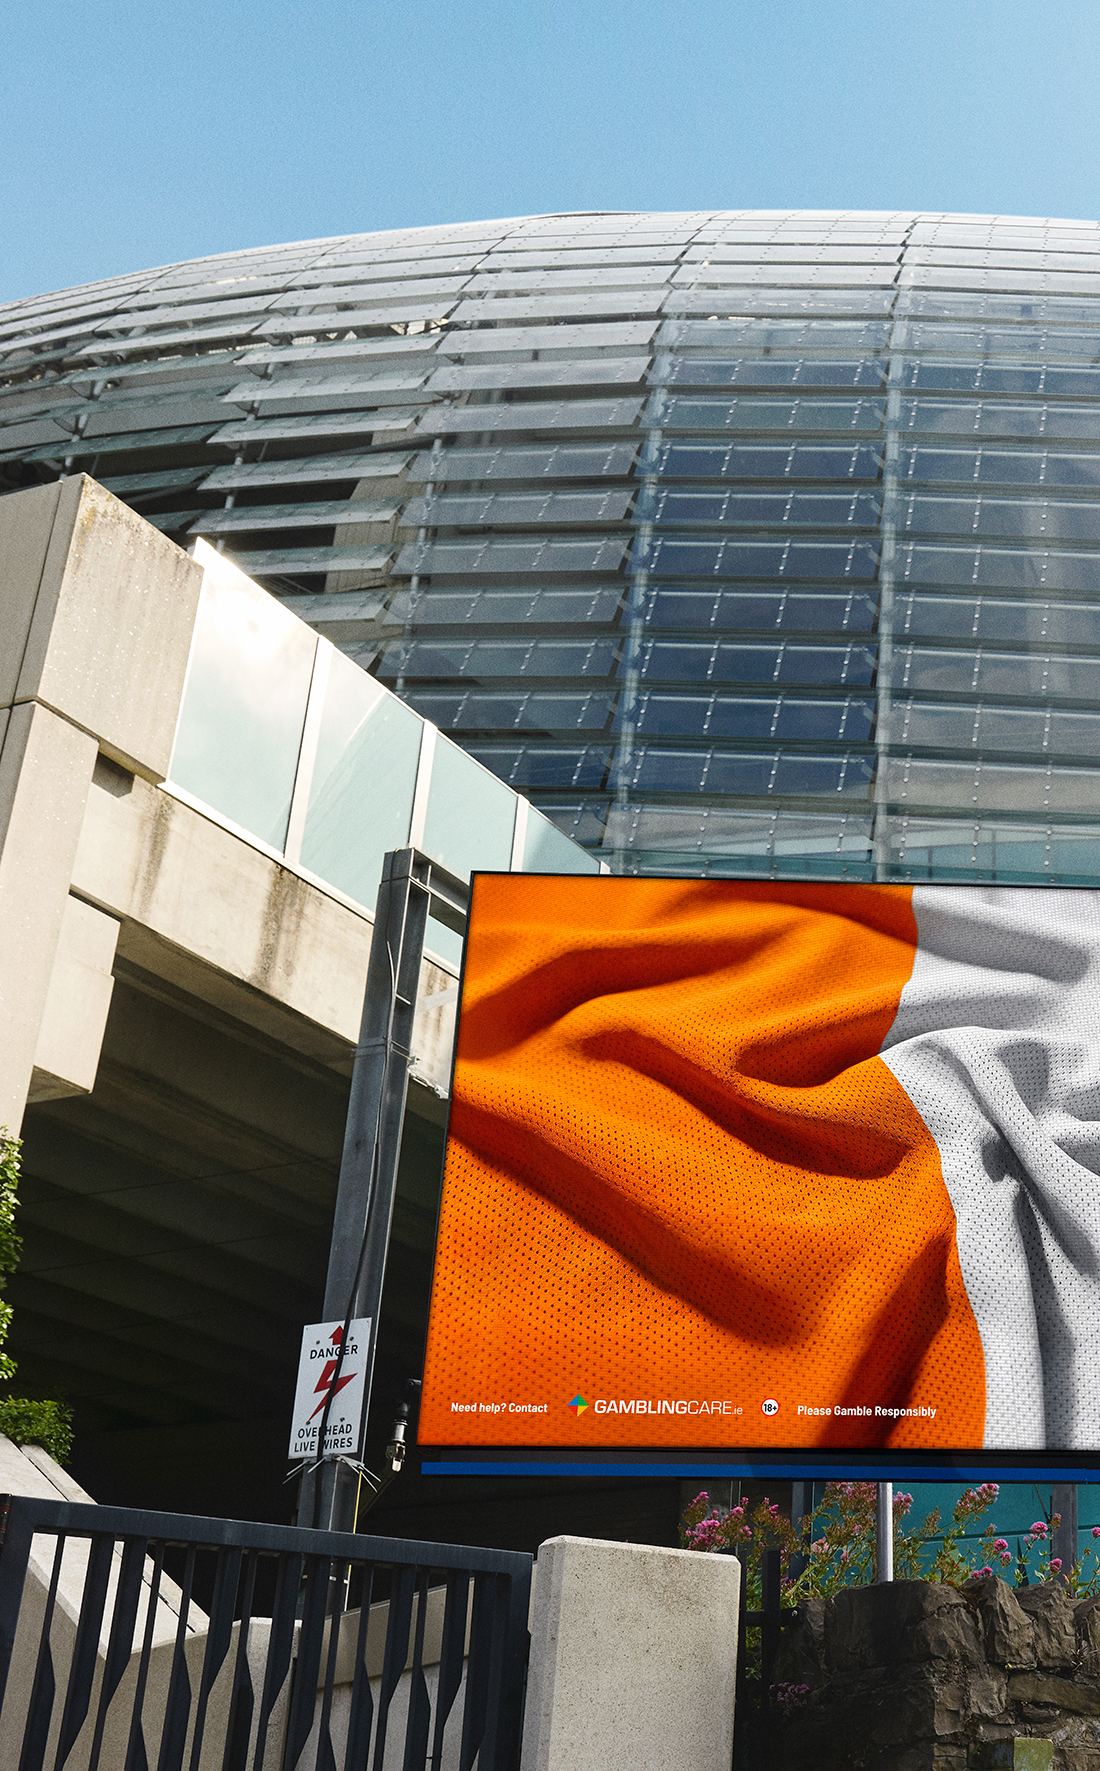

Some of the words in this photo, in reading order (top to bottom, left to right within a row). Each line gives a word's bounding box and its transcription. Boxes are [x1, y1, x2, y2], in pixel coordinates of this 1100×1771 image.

[310, 1344, 358, 1359] DANGER
[451, 1402, 477, 1412] Need
[479, 1402, 506, 1414] help?
[508, 1403, 548, 1413] Contact
[763, 1403, 778, 1412] 18+
[797, 1405, 832, 1416] Please
[834, 1405, 872, 1416] Gamble
[875, 1406, 937, 1419] Responsibly
[294, 1441, 316, 1452] LIVE
